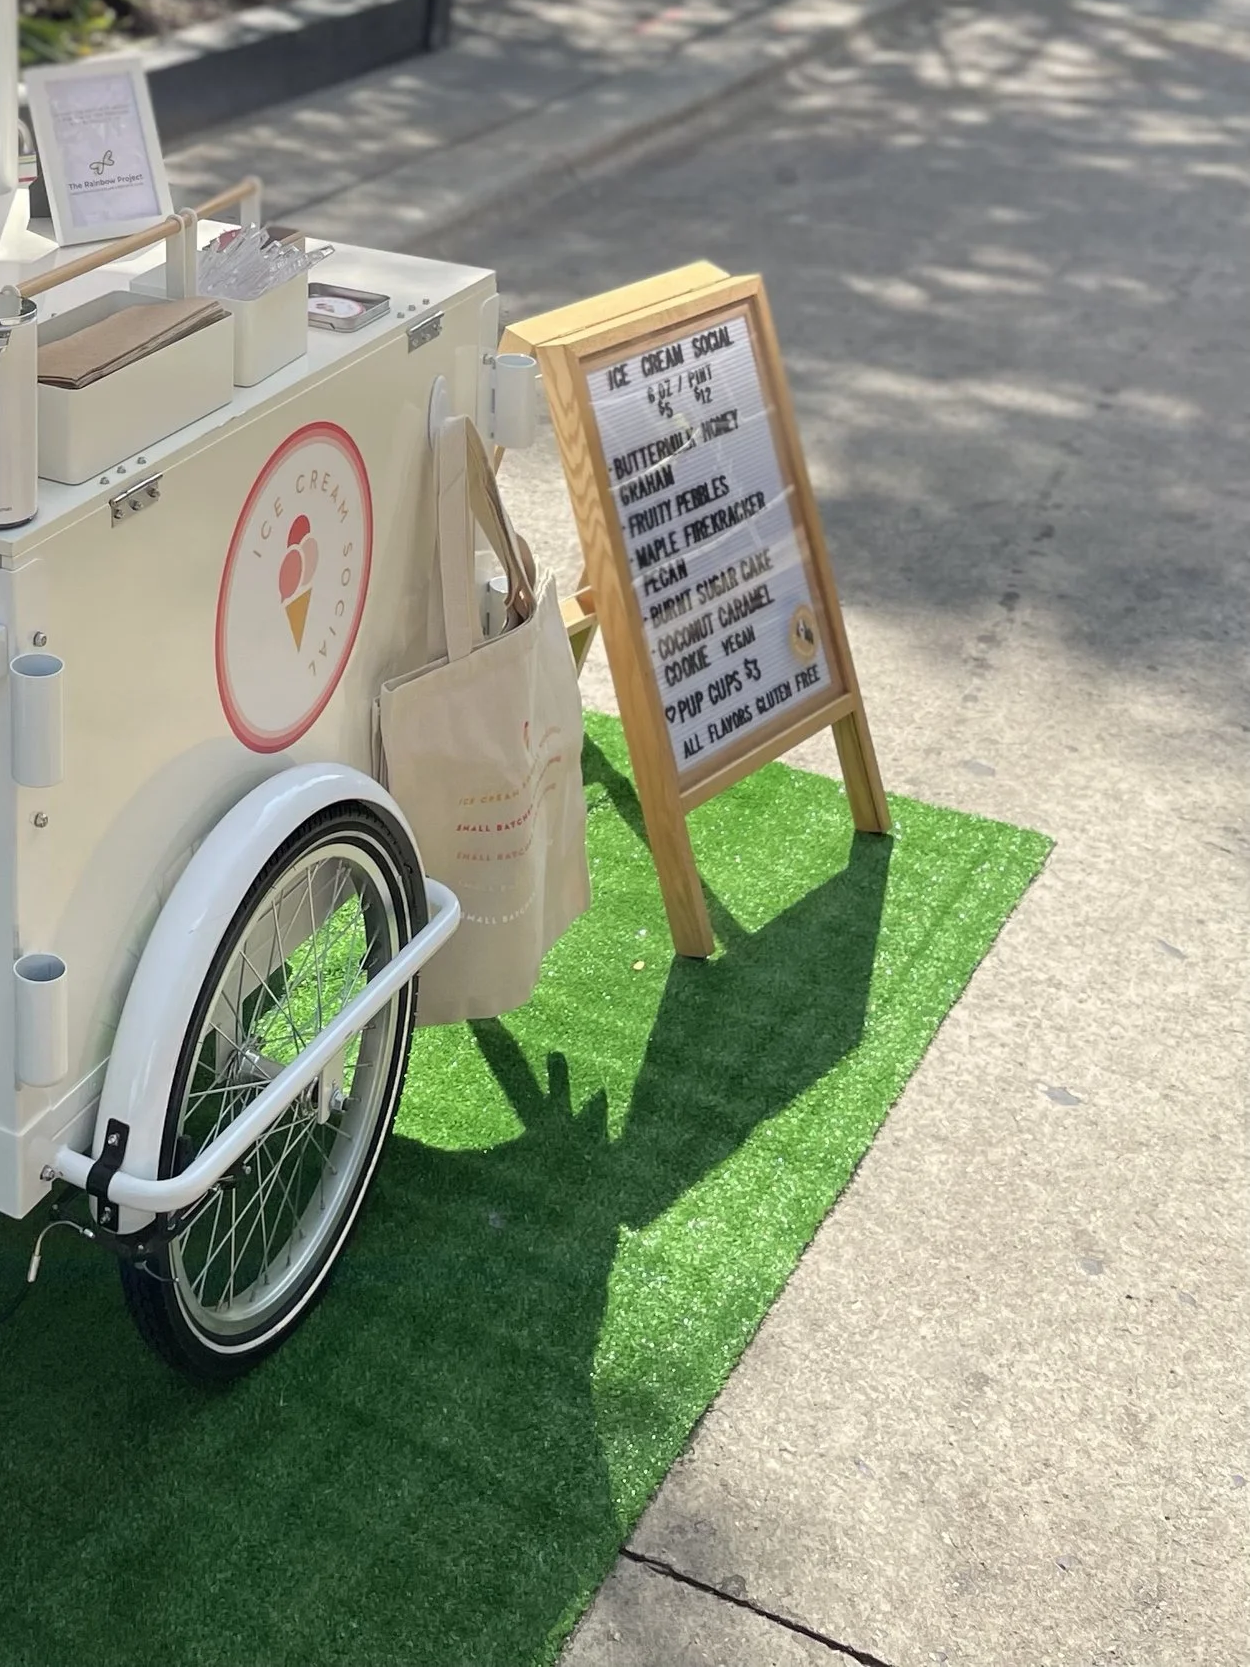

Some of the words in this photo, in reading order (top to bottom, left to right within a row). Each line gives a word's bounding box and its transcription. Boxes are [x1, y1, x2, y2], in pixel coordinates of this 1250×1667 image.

[68, 183, 83, 191] The
[84, 178, 116, 188] Rainbow
[117, 174, 143, 183] Project
[607, 364, 631, 391] ICE
[641, 343, 684, 377] CREAM
[691, 326, 734, 358] SOCIAL
[658, 380, 673, 400] OZ
[688, 364, 712, 388] PINT
[658, 400, 673, 418] $5
[694, 386, 713, 405] $12
[613, 426, 697, 480] BUTTERMILK
[701, 408, 738, 443] HONEY
[295, 469, 349, 524] CREAM
[620, 464, 675, 506] GRAHAM
[628, 499, 672, 538] FRUITY
[676, 475, 730, 516] PEBBLES
[253, 497, 284, 558] ICE
[635, 531, 680, 570] MAPLE
[644, 557, 688, 597] PECAN
[650, 588, 693, 629] BURNT
[696, 566, 739, 605] SUGAR
[740, 548, 774, 581] CAKE
[307, 541, 353, 677] SOCIAL
[657, 613, 714, 661] COCONUT
[718, 584, 775, 629] CARAMEL
[664, 644, 712, 687] COOKIE
[721, 625, 756, 656] VEGAN
[677, 690, 704, 723] PUP
[708, 670, 743, 705] CUPS
[743, 658, 761, 681] $3
[683, 732, 705, 759] ALL
[707, 705, 753, 744] FLAVORS
[755, 681, 792, 715] GLUTEN
[795, 664, 821, 692] FREE
[456, 824, 490, 832] SMALL
